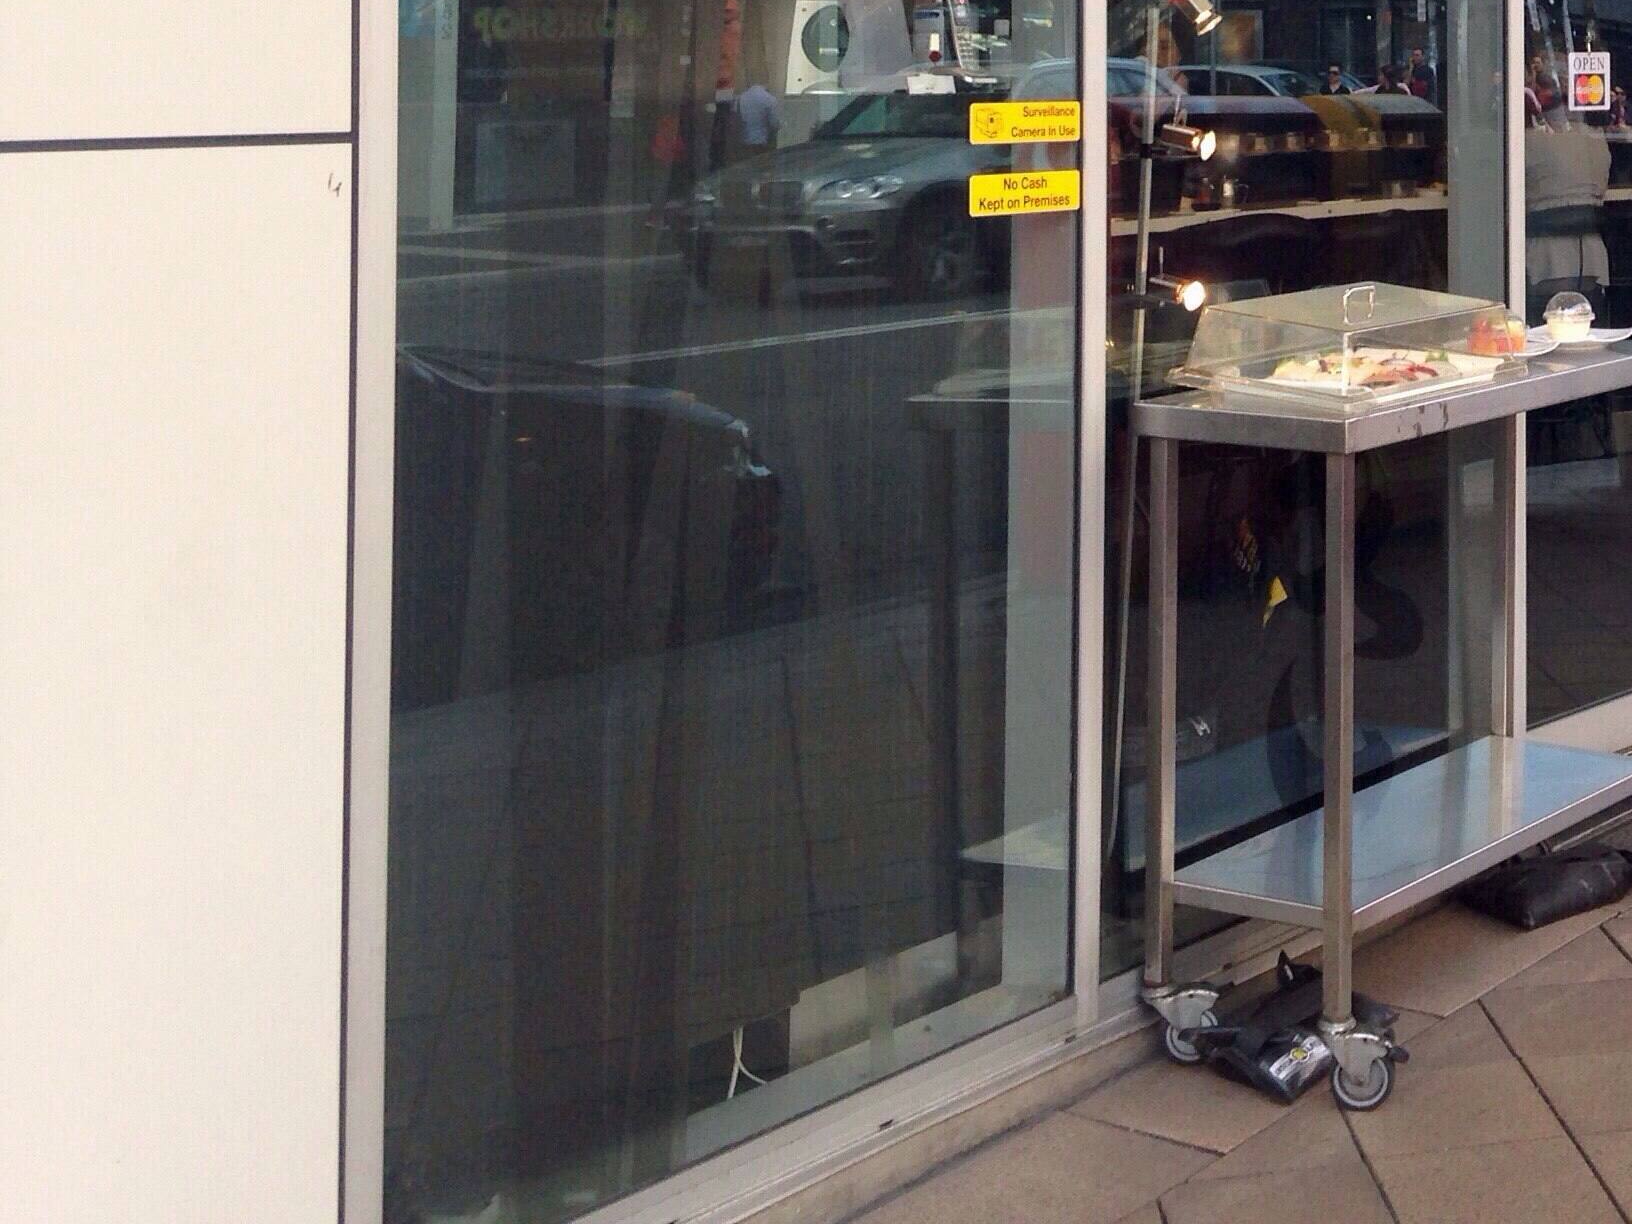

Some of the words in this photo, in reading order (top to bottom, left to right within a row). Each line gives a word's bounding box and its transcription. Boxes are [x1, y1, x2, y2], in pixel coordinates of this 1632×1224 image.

[1573, 56, 1605, 71] OPEN
[1023, 105, 1075, 117] Surveillance
[1011, 126, 1046, 137] Camera
[1058, 125, 1076, 136] Use
[1003, 178, 1018, 190] No
[1021, 176, 1048, 189] Cash
[979, 197, 1004, 212] Kept
[1007, 198, 1020, 208] on
[1023, 194, 1070, 207] Premises
